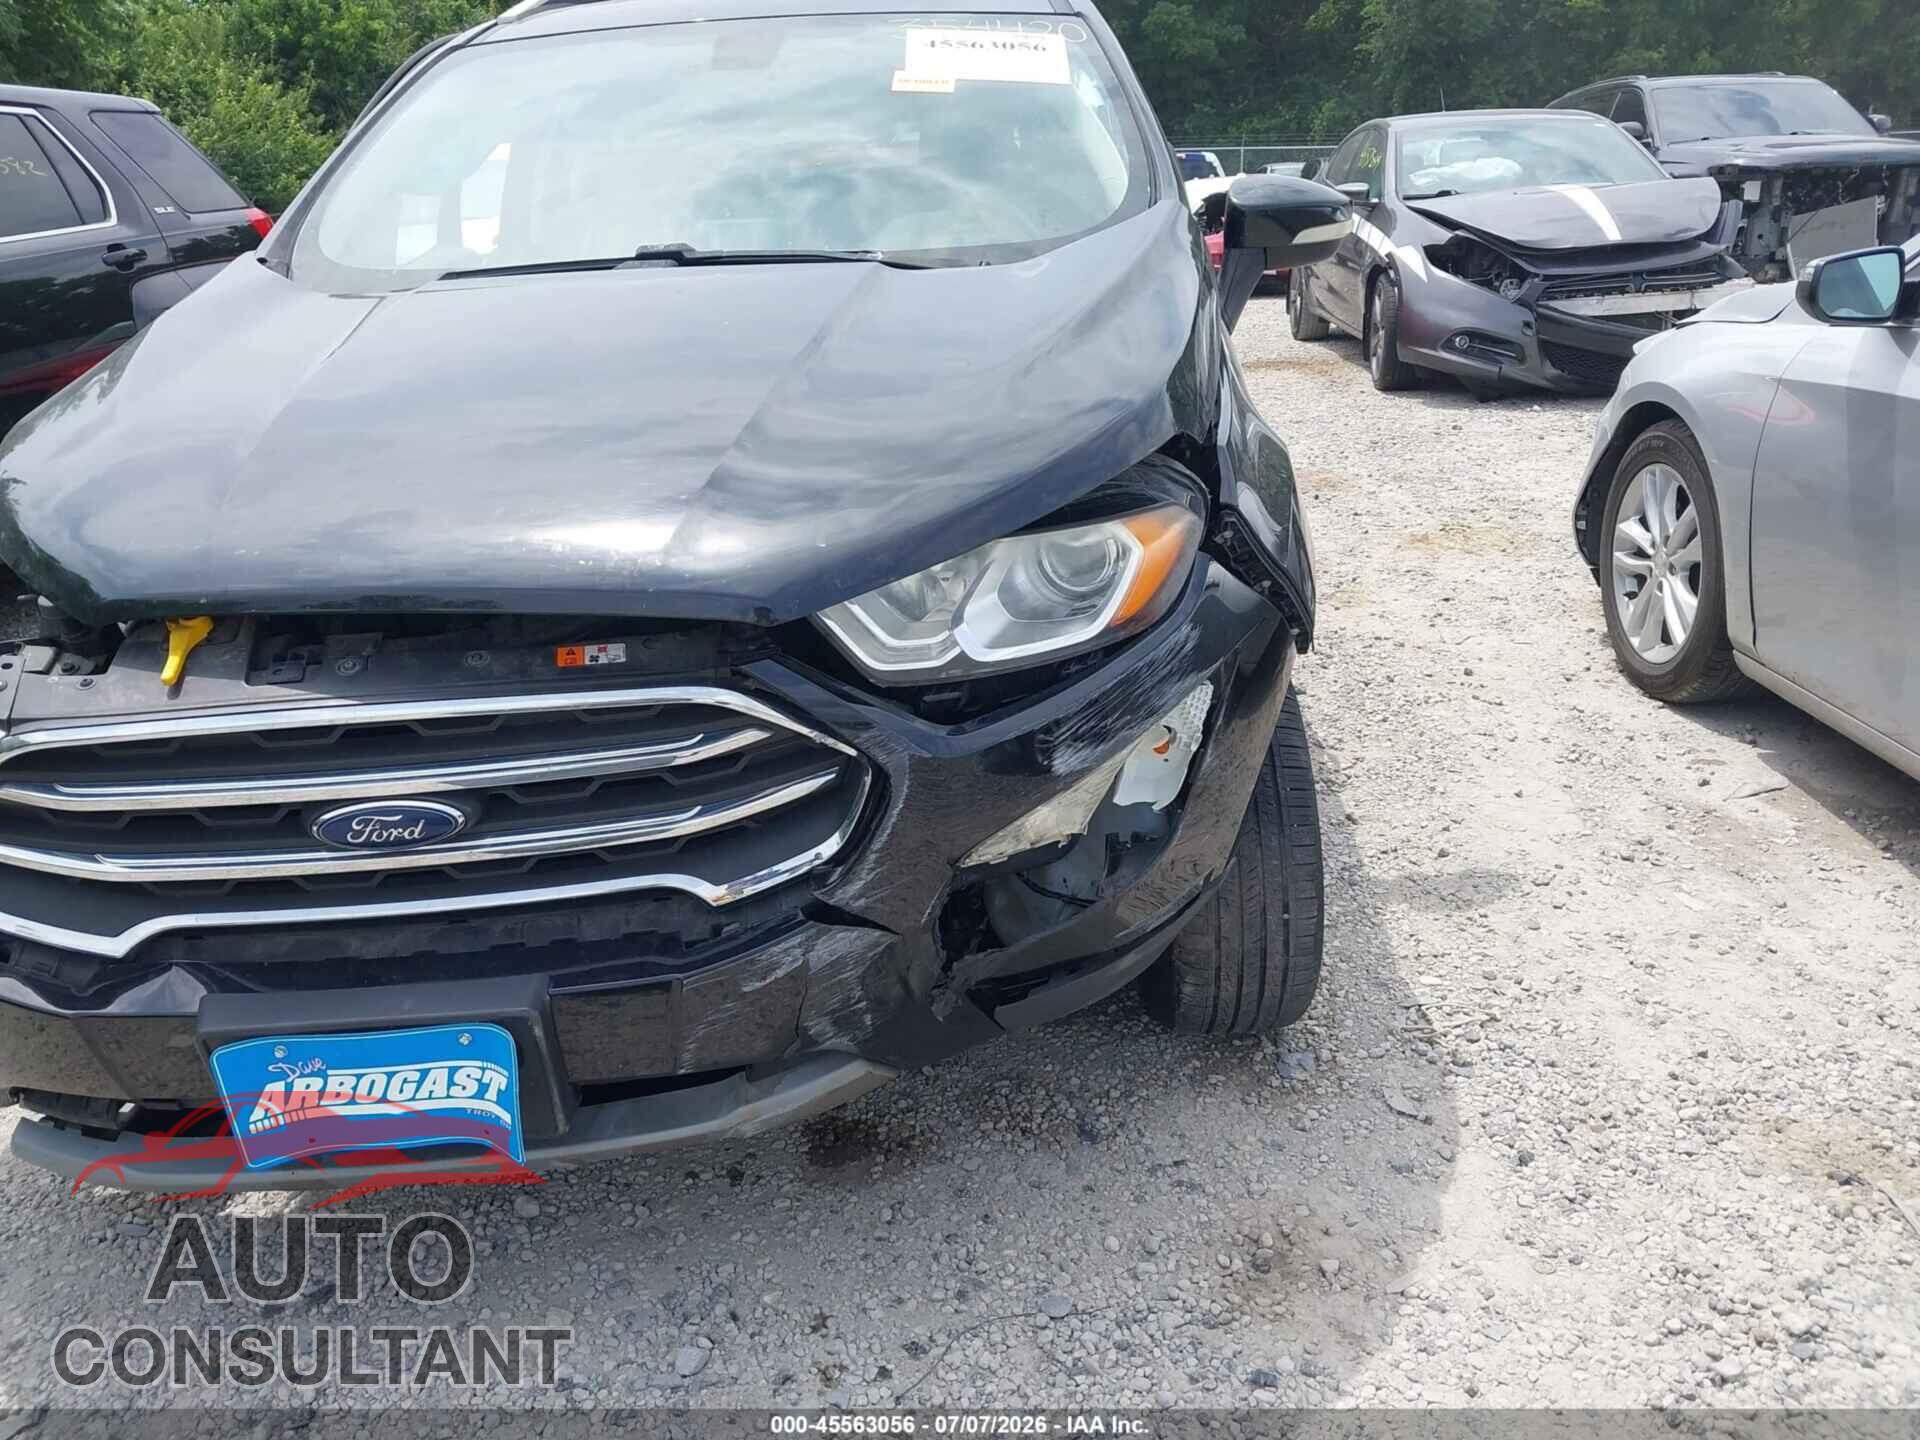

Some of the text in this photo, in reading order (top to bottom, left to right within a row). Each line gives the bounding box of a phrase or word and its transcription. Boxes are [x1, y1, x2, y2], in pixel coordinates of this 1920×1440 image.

[346, 814, 426, 843] Ford
[267, 1055, 328, 1082] Dave
[248, 1066, 509, 1122] ARBOGAST
